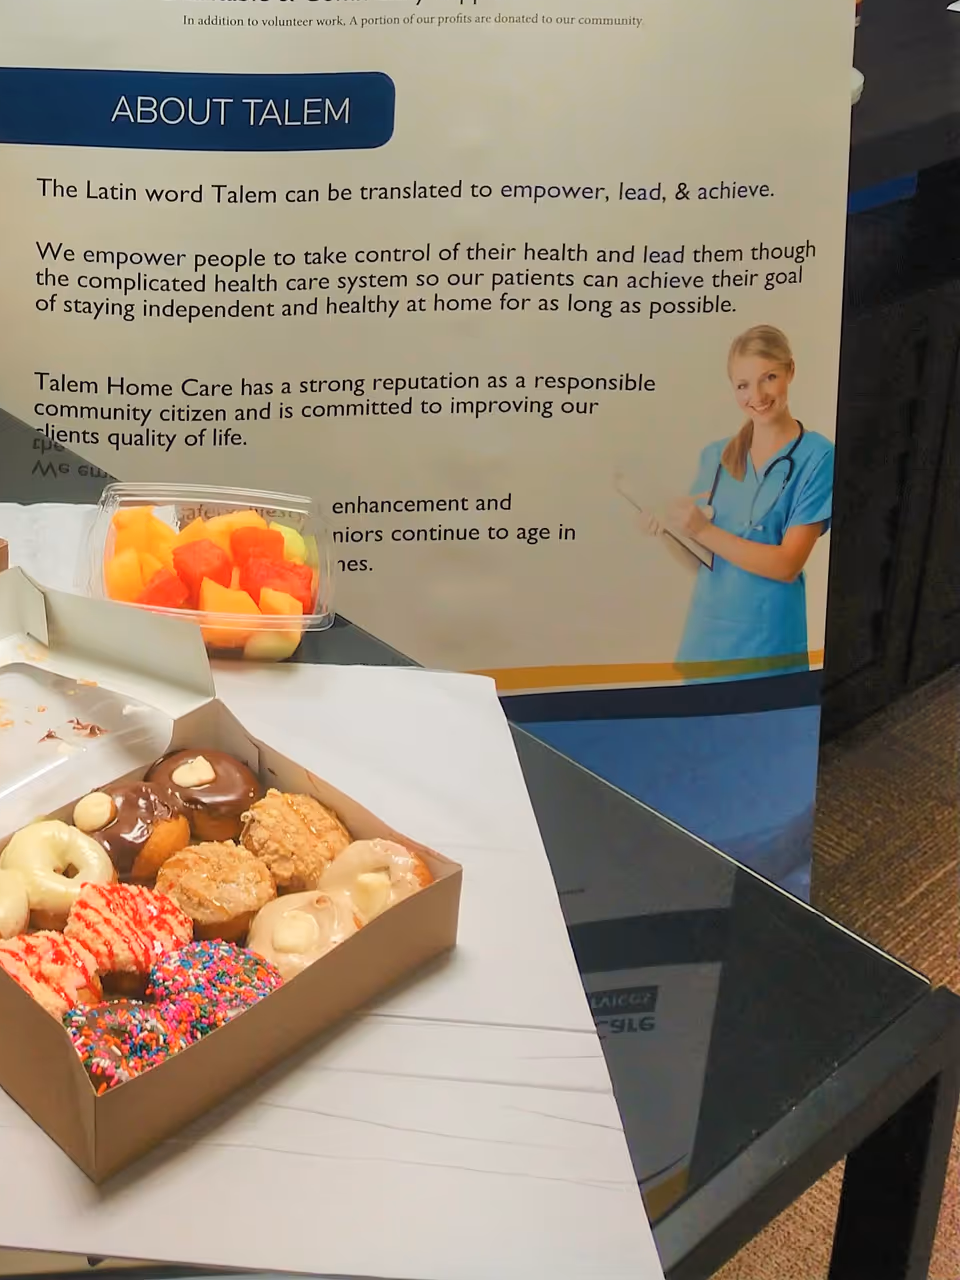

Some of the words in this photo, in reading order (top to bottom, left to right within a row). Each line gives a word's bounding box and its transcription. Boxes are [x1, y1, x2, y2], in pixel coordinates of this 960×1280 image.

[111, 96, 234, 125] ABOUT
[242, 98, 349, 126] TALEM
[36, 177, 78, 198] The
[86, 180, 137, 201] Latin
[145, 184, 203, 203] word
[211, 184, 277, 204] Talem
[285, 189, 319, 203] can
[328, 182, 352, 202] be
[360, 180, 462, 200] translated
[470, 184, 492, 198] to
[500, 185, 609, 203] empower,
[619, 182, 666, 203] lead,
[675, 182, 690, 201] &
[698, 181, 774, 200] achieve.
[36, 241, 75, 262] We
[83, 250, 187, 268] empower
[194, 248, 266, 272] people
[273, 252, 296, 266] to
[304, 246, 347, 265] take
[355, 243, 430, 263] control
[438, 242, 461, 261] of
[466, 242, 517, 261] their
[524, 242, 588, 262] health
[596, 245, 635, 263] and
[643, 245, 685, 264] lead
[693, 244, 743, 263] them
[750, 240, 816, 264] though
[36, 268, 69, 287] the
[77, 271, 206, 294] complicated
[214, 269, 278, 293] health
[286, 277, 330, 291] care
[337, 274, 408, 294] system
[416, 273, 439, 287] so
[447, 273, 485, 286] our
[492, 269, 574, 291] patients
[583, 274, 618, 288] can
[626, 271, 704, 289] achieve
[712, 269, 759, 288] their
[764, 266, 803, 291] goal
[34, 371, 98, 394] Talem
[108, 376, 173, 397] Home
[181, 378, 233, 397] Care
[241, 377, 274, 396] has
[281, 381, 292, 395] a
[300, 378, 365, 397] strong
[373, 373, 479, 396] reputation
[487, 375, 508, 389] as
[515, 375, 526, 389] a
[534, 373, 656, 394] responsible
[35, 422, 101, 445] lients
[108, 428, 177, 452] quality
[184, 428, 207, 447] of
[213, 428, 247, 446] life.
[332, 496, 469, 514] enhancement
[475, 492, 512, 511] and
[391, 525, 480, 542] continue
[488, 526, 509, 540] to
[516, 527, 550, 545] age
[558, 523, 576, 541] in
